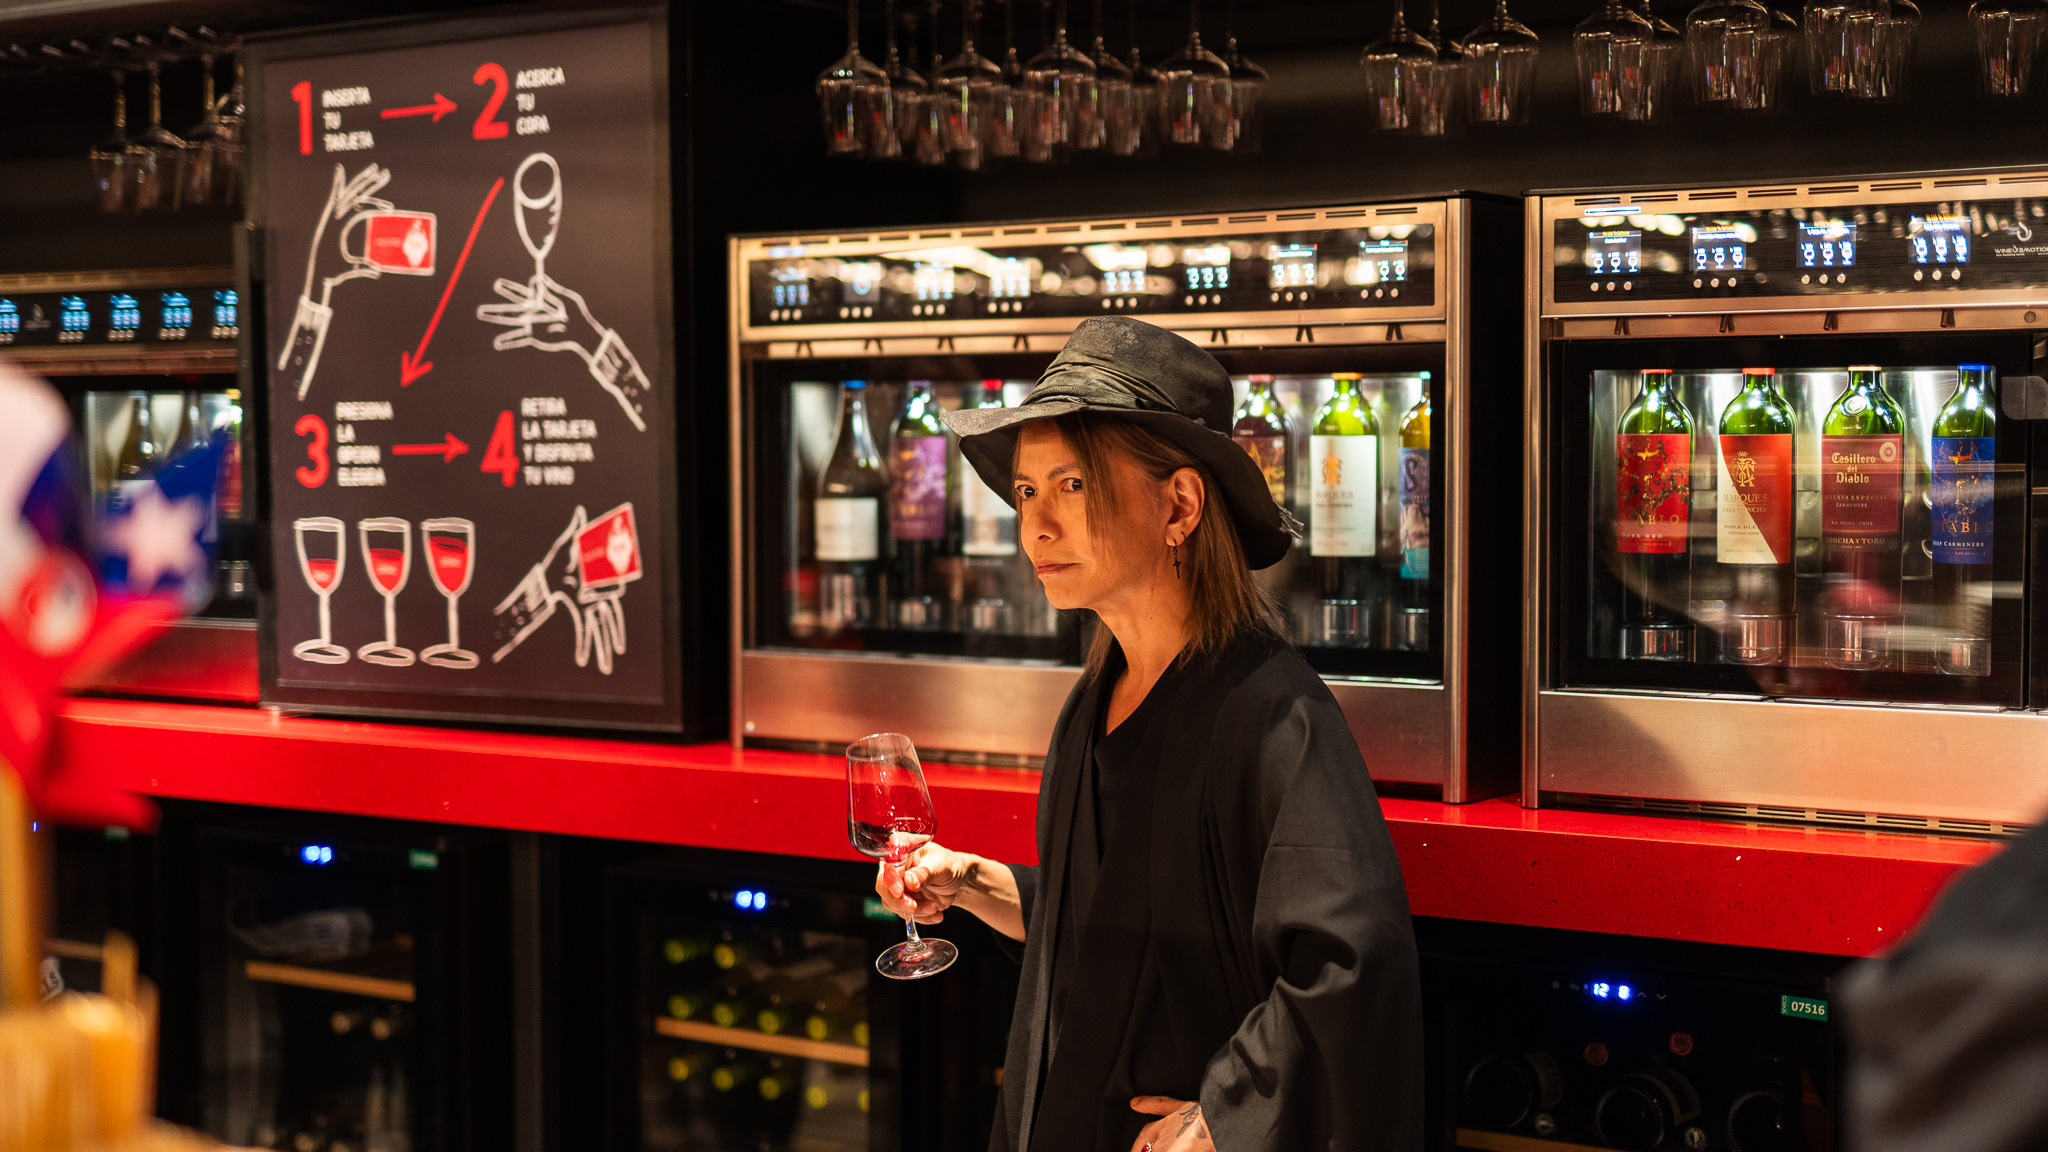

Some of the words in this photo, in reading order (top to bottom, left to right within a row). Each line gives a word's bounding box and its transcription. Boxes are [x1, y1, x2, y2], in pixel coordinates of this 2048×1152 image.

[515, 66, 566, 89] ACERCA
[322, 86, 371, 108] INSERTA
[473, 62, 509, 140] 2
[516, 92, 536, 112] TU
[291, 81, 312, 155] 1
[323, 111, 342, 130] TU
[516, 114, 550, 136] COPA
[323, 130, 375, 152] TARJETA
[521, 397, 568, 417] RETIRA
[336, 423, 356, 443] LA
[521, 420, 542, 440] LA
[542, 419, 598, 440] TARJETA
[294, 413, 329, 488] 3
[480, 410, 519, 487] 4
[523, 443, 533, 463] Y
[534, 442, 595, 463] DISFRUTA
[1831, 452, 1876, 464] Casillero
[523, 466, 543, 486] TU
[543, 465, 575, 486] VINO
[1835, 471, 1870, 484] Diablo
[1846, 465, 1858, 473] del
[1723, 493, 1768, 504] MARQUES
[1861, 537, 1886, 545] TORO
[1943, 540, 1985, 548] CARMENERE
[1594, 982, 1610, 998] 12
[1791, 1000, 1825, 1016] 07516
